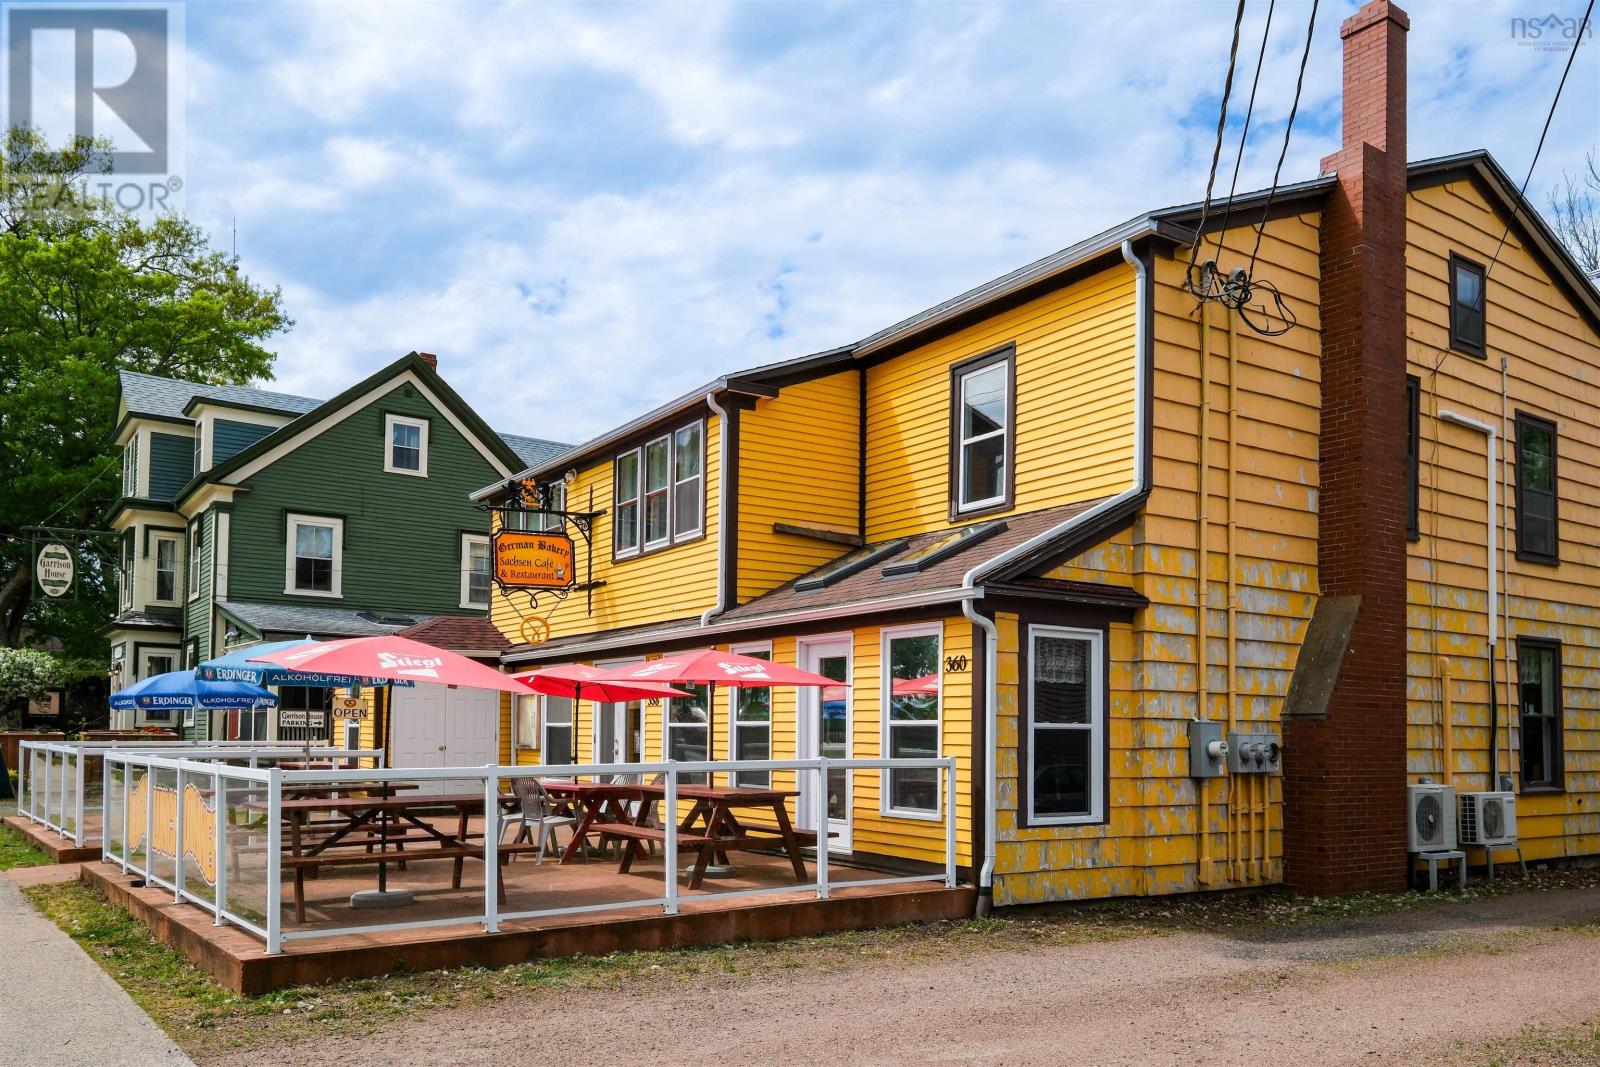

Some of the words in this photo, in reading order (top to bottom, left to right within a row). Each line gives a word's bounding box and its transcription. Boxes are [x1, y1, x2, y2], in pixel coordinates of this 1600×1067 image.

[498, 542, 534, 553] German
[537, 540, 569, 558] Bakery
[40, 558, 71, 569] Garrison
[500, 556, 532, 567] Sachsen
[534, 557, 554, 570] Café
[44, 568, 66, 579] House
[500, 569, 508, 578] &
[510, 570, 554, 580] Restaurant
[377, 652, 443, 669] Stiegl
[945, 655, 967, 673] 360
[216, 668, 258, 683] ERDINGER
[272, 673, 352, 684] ALKOHOLFREI
[153, 696, 193, 706] ERDINGER
[281, 711, 306, 720] Garrison
[333, 707, 367, 719] OPEN
